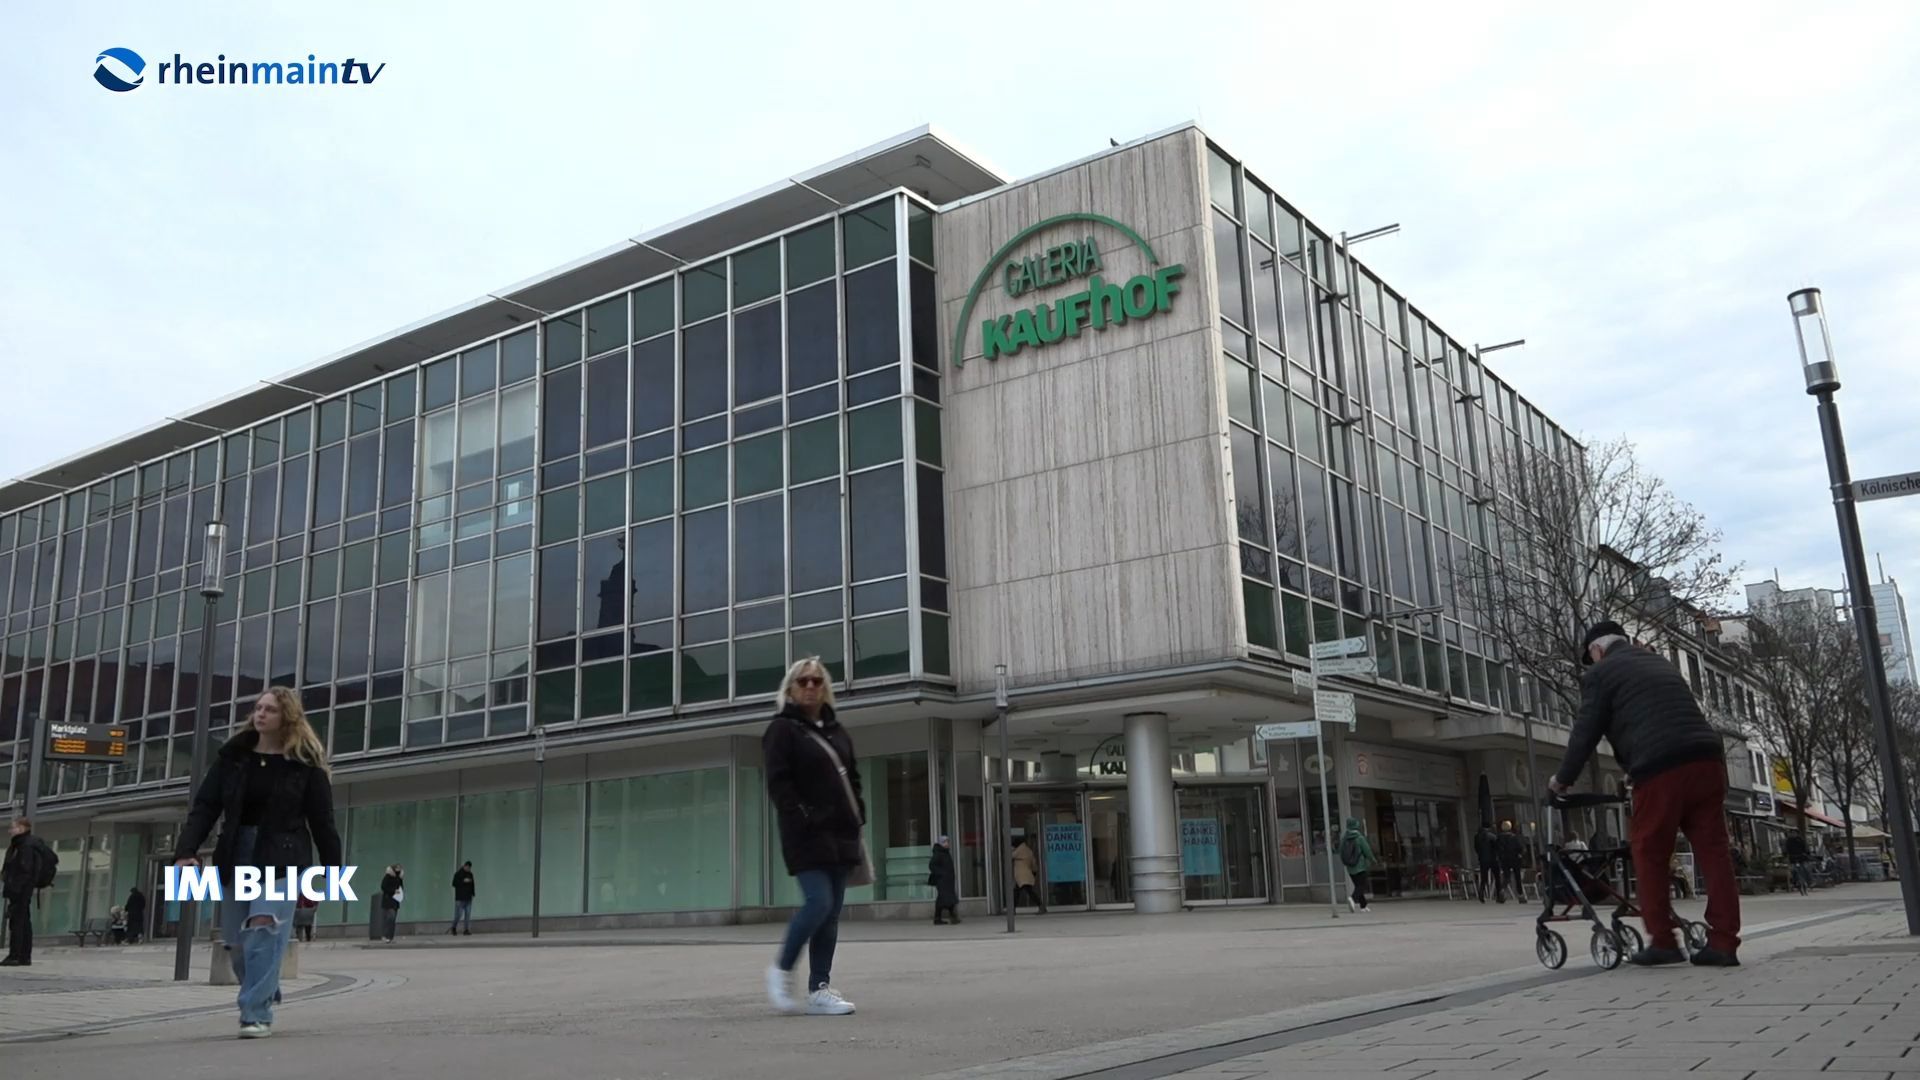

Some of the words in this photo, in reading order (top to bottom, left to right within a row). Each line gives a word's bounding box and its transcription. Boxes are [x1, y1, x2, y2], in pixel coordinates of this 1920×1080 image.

[1002, 236, 1103, 297] GALERIA
[51, 724, 88, 734] Marktplatz
[1183, 836, 1217, 845] HANAU
[1047, 842, 1082, 852] HANAU
